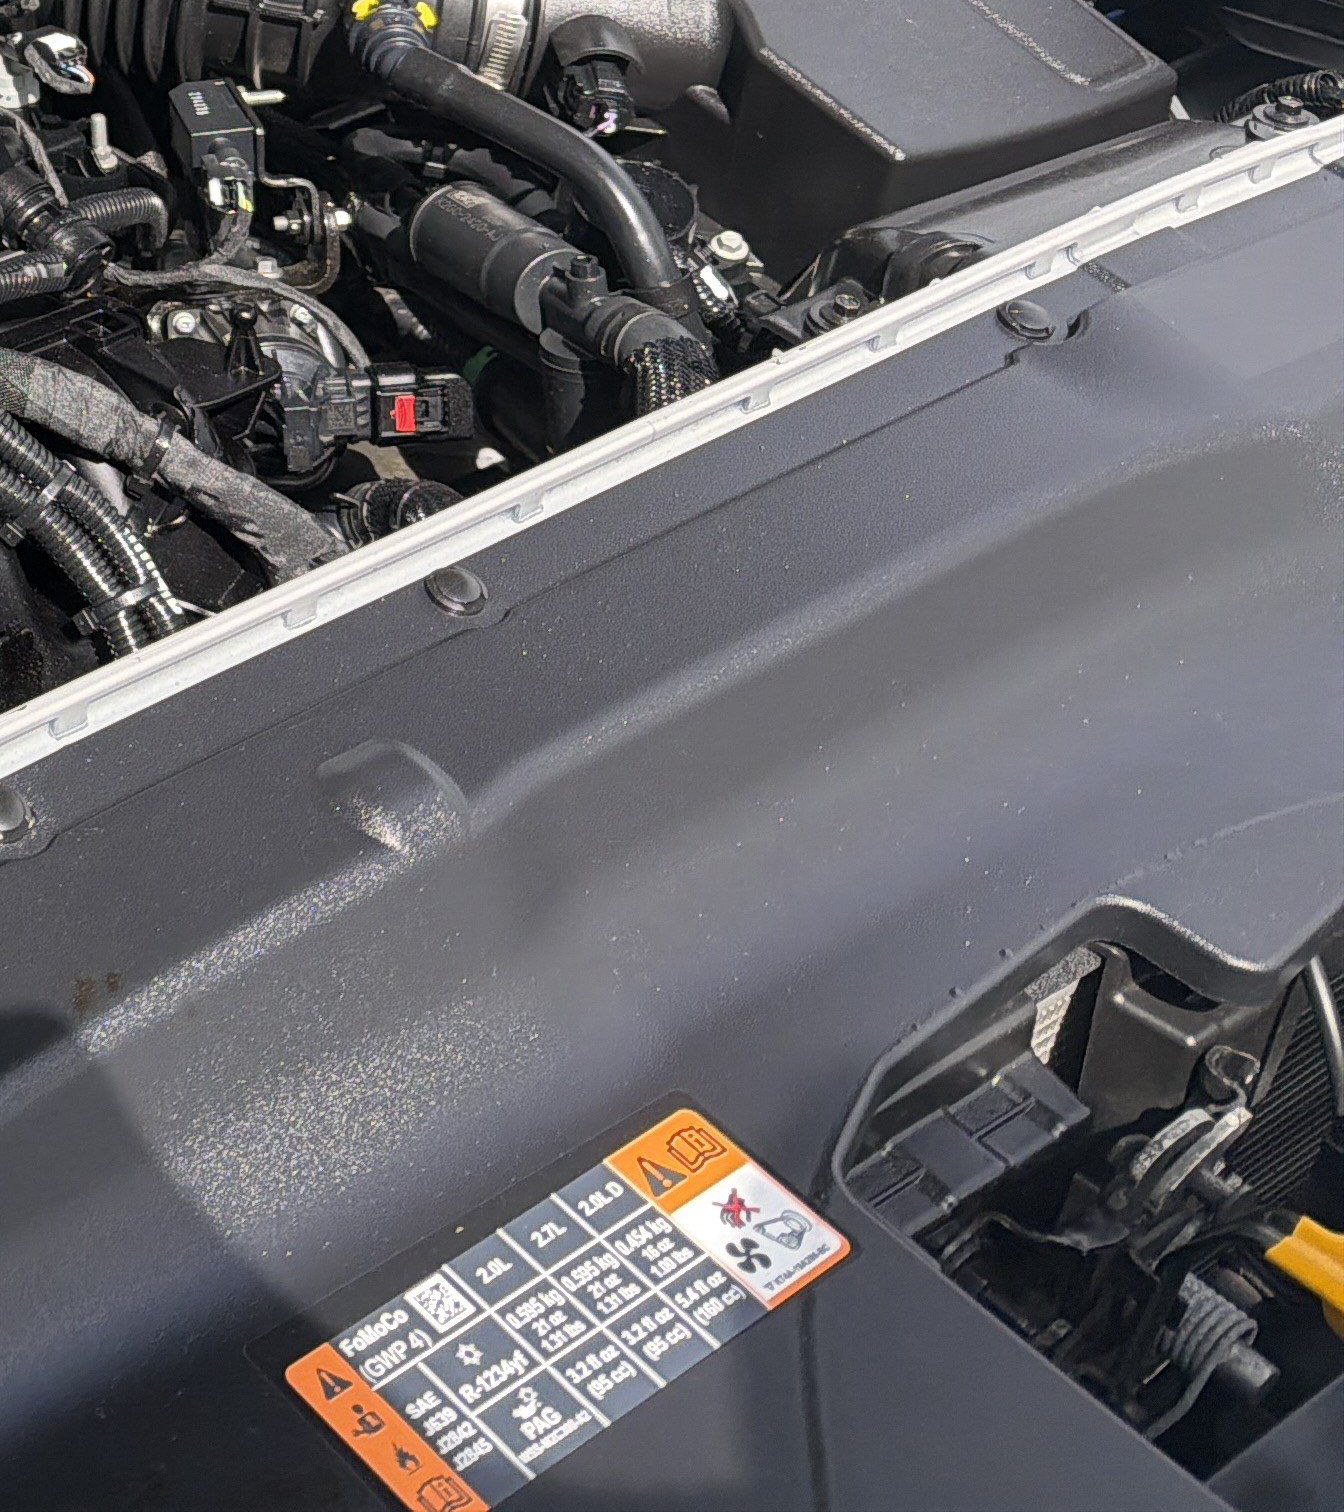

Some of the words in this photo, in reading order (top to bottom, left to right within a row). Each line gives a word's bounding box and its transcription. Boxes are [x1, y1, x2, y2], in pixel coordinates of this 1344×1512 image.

[577, 1192, 612, 1217] 2.0L
[611, 1181, 624, 1200] D
[530, 1223, 568, 1248] 2.7L
[650, 1217, 674, 1240] kg
[658, 1238, 675, 1254] oz
[675, 1246, 695, 1265] lbs
[476, 1258, 513, 1285] 2.0L
[598, 1252, 620, 1275] kg
[604, 1273, 622, 1289] oz
[706, 1270, 728, 1287] oz
[542, 1288, 566, 1313] kg
[621, 1282, 642, 1303] lbs
[721, 1286, 749, 1309] cc)
[548, 1311, 568, 1327] oz
[567, 1320, 587, 1340] lbs
[621, 1323, 646, 1346] 3.2
[655, 1308, 675, 1326] oz
[338, 1309, 409, 1357] FoMoCo
[642, 1335, 668, 1361] (95
[665, 1322, 693, 1346] cc)
[359, 1343, 410, 1383] (GWP
[409, 1329, 434, 1349] 4)
[565, 1360, 591, 1384] 3.2
[600, 1345, 620, 1363] oz
[459, 1349, 530, 1403] R-1234yf
[586, 1372, 612, 1400] (95
[609, 1360, 637, 1385] cc)
[405, 1391, 442, 1419] SAE
[519, 1405, 562, 1440] PAG
